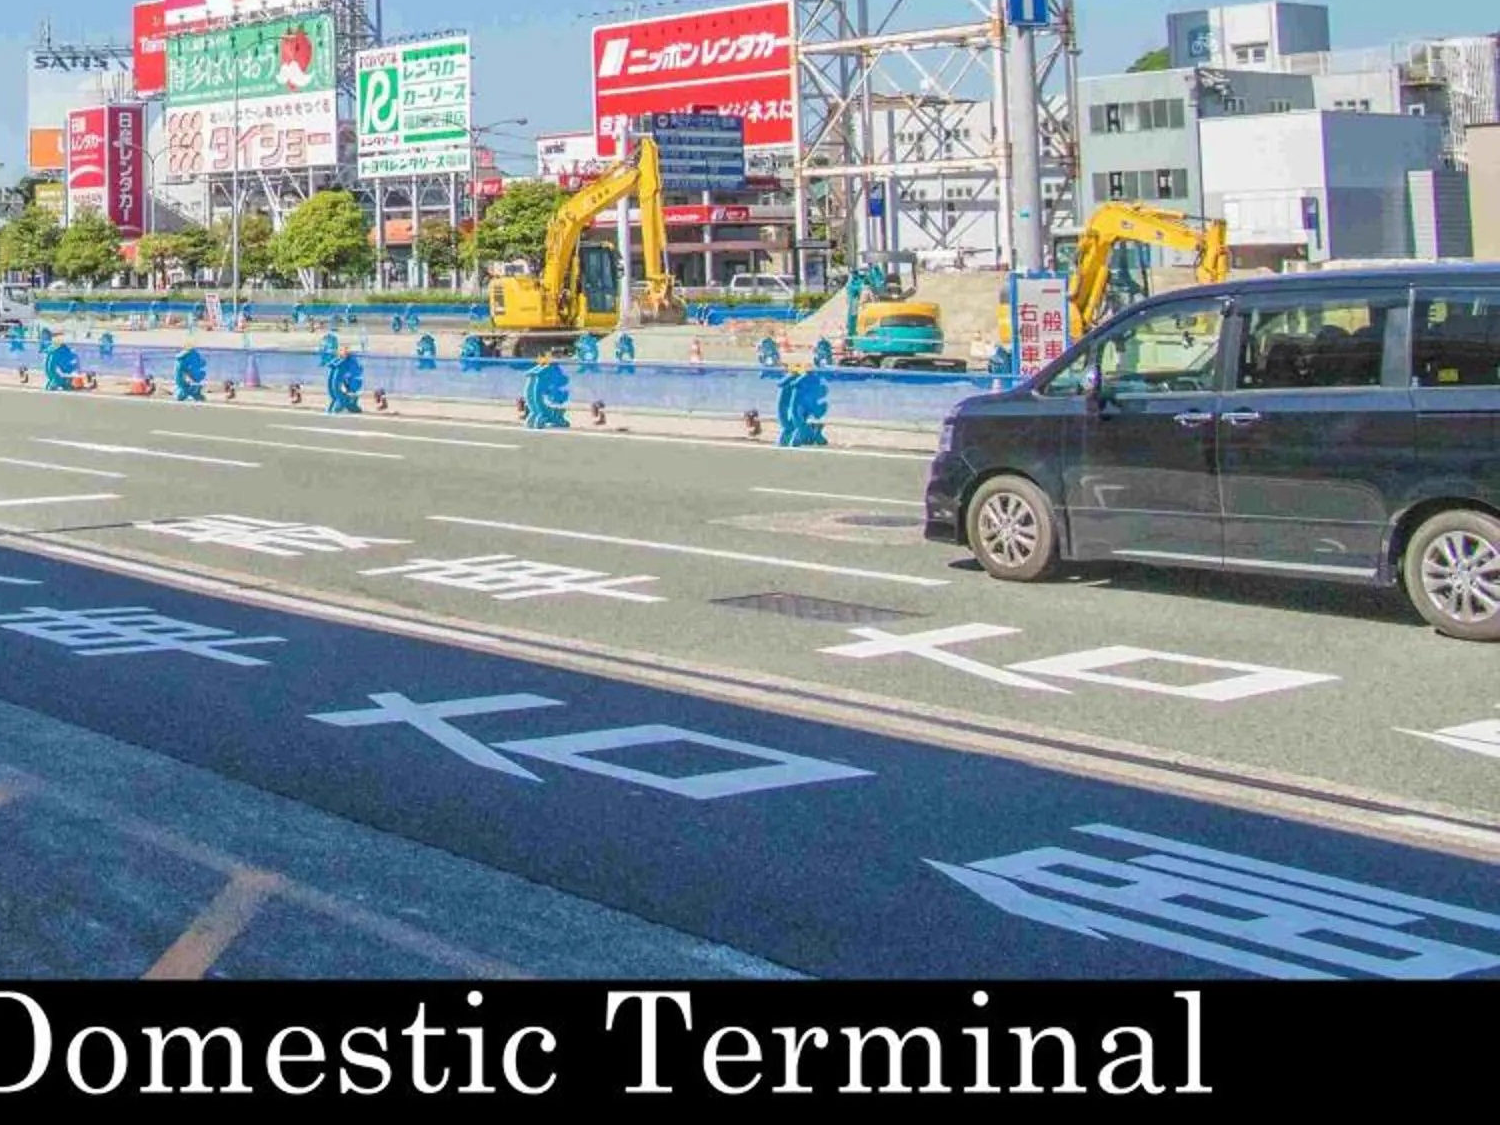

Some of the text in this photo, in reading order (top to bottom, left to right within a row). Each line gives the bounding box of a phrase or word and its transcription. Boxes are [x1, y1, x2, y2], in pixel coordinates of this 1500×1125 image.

[403, 59, 467, 81] レンタカー
[403, 83, 467, 105] カーリース
[1041, 287, 1063, 360] 一般車
